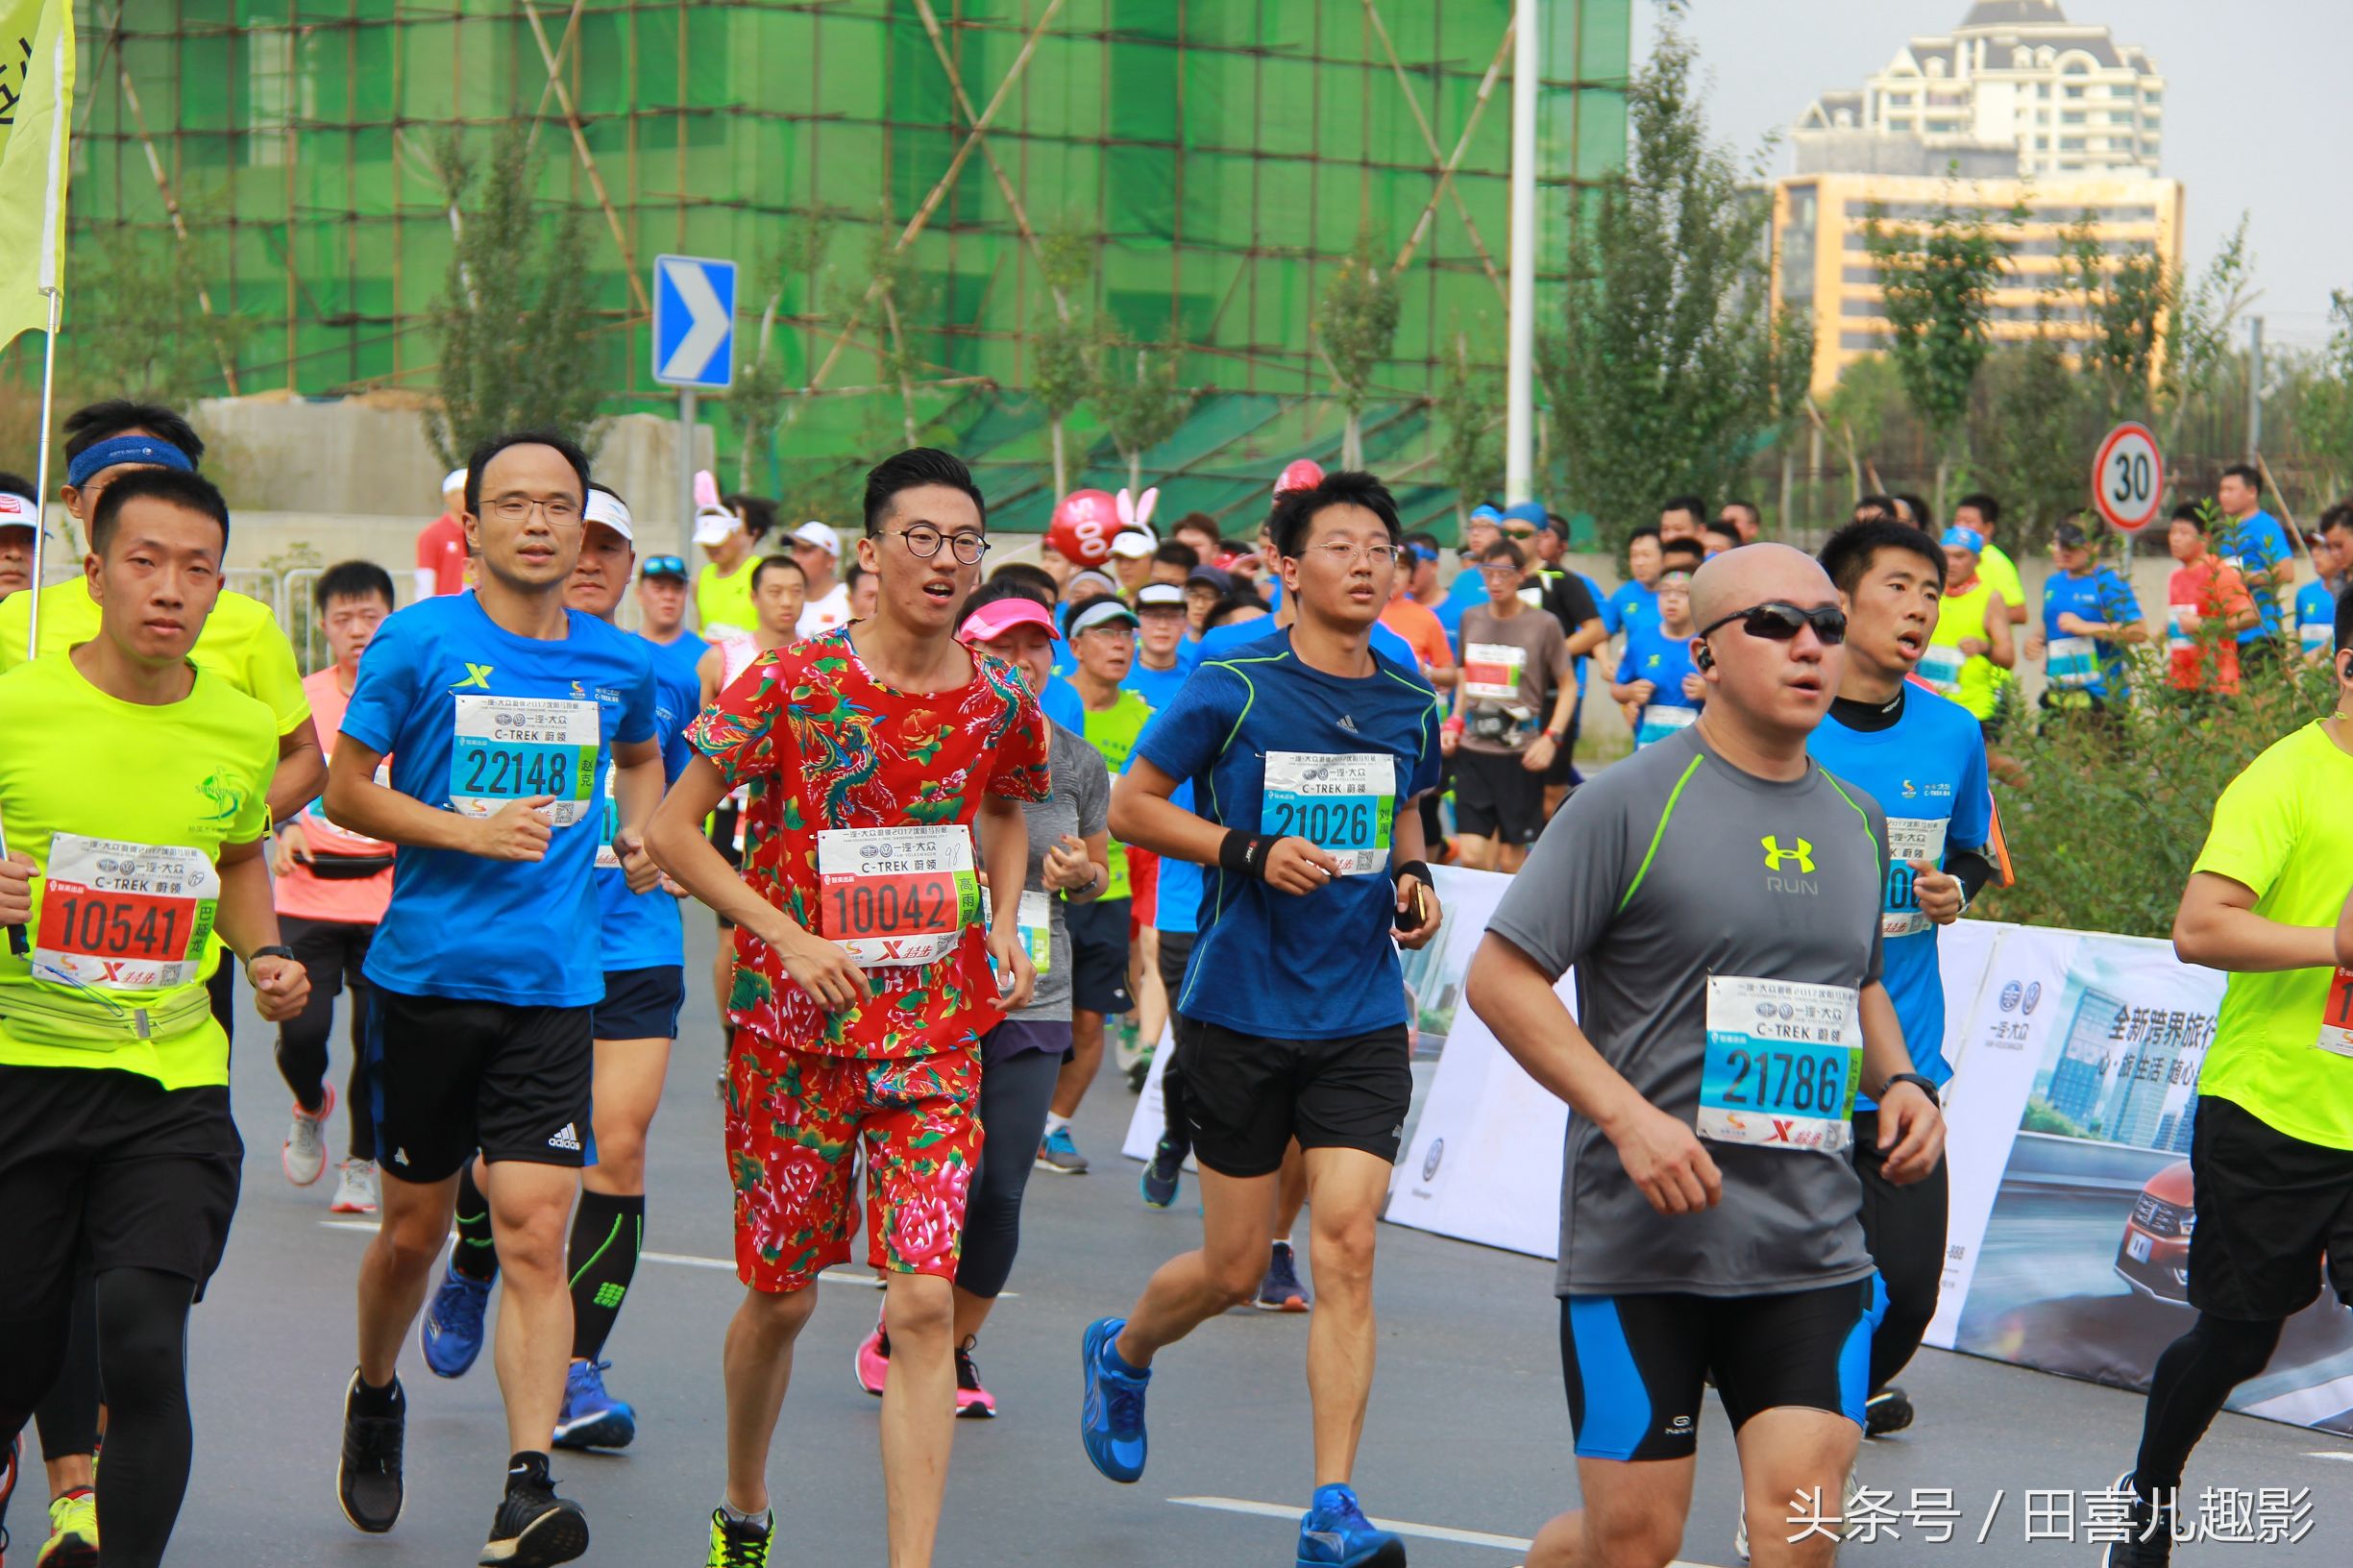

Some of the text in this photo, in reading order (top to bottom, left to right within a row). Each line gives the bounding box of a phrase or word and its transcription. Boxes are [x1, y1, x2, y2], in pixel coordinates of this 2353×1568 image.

[2114, 453, 2149, 501] 30
[494, 729, 539, 741] C-TREK
[465, 748, 567, 796] 22148
[1302, 783, 1342, 794] C-TREK
[1275, 803, 1367, 845] 21026
[861, 859, 937, 873] C-TREK 蔚领
[94, 875, 149, 892] C-TREK
[1766, 876, 1820, 895] RUN
[833, 882, 946, 934] 10042
[62, 897, 177, 955] 10541
[1756, 1021, 1811, 1040] C-TREK
[1722, 1048, 1840, 1114] 21786
[548, 1138, 581, 1151] adidas
